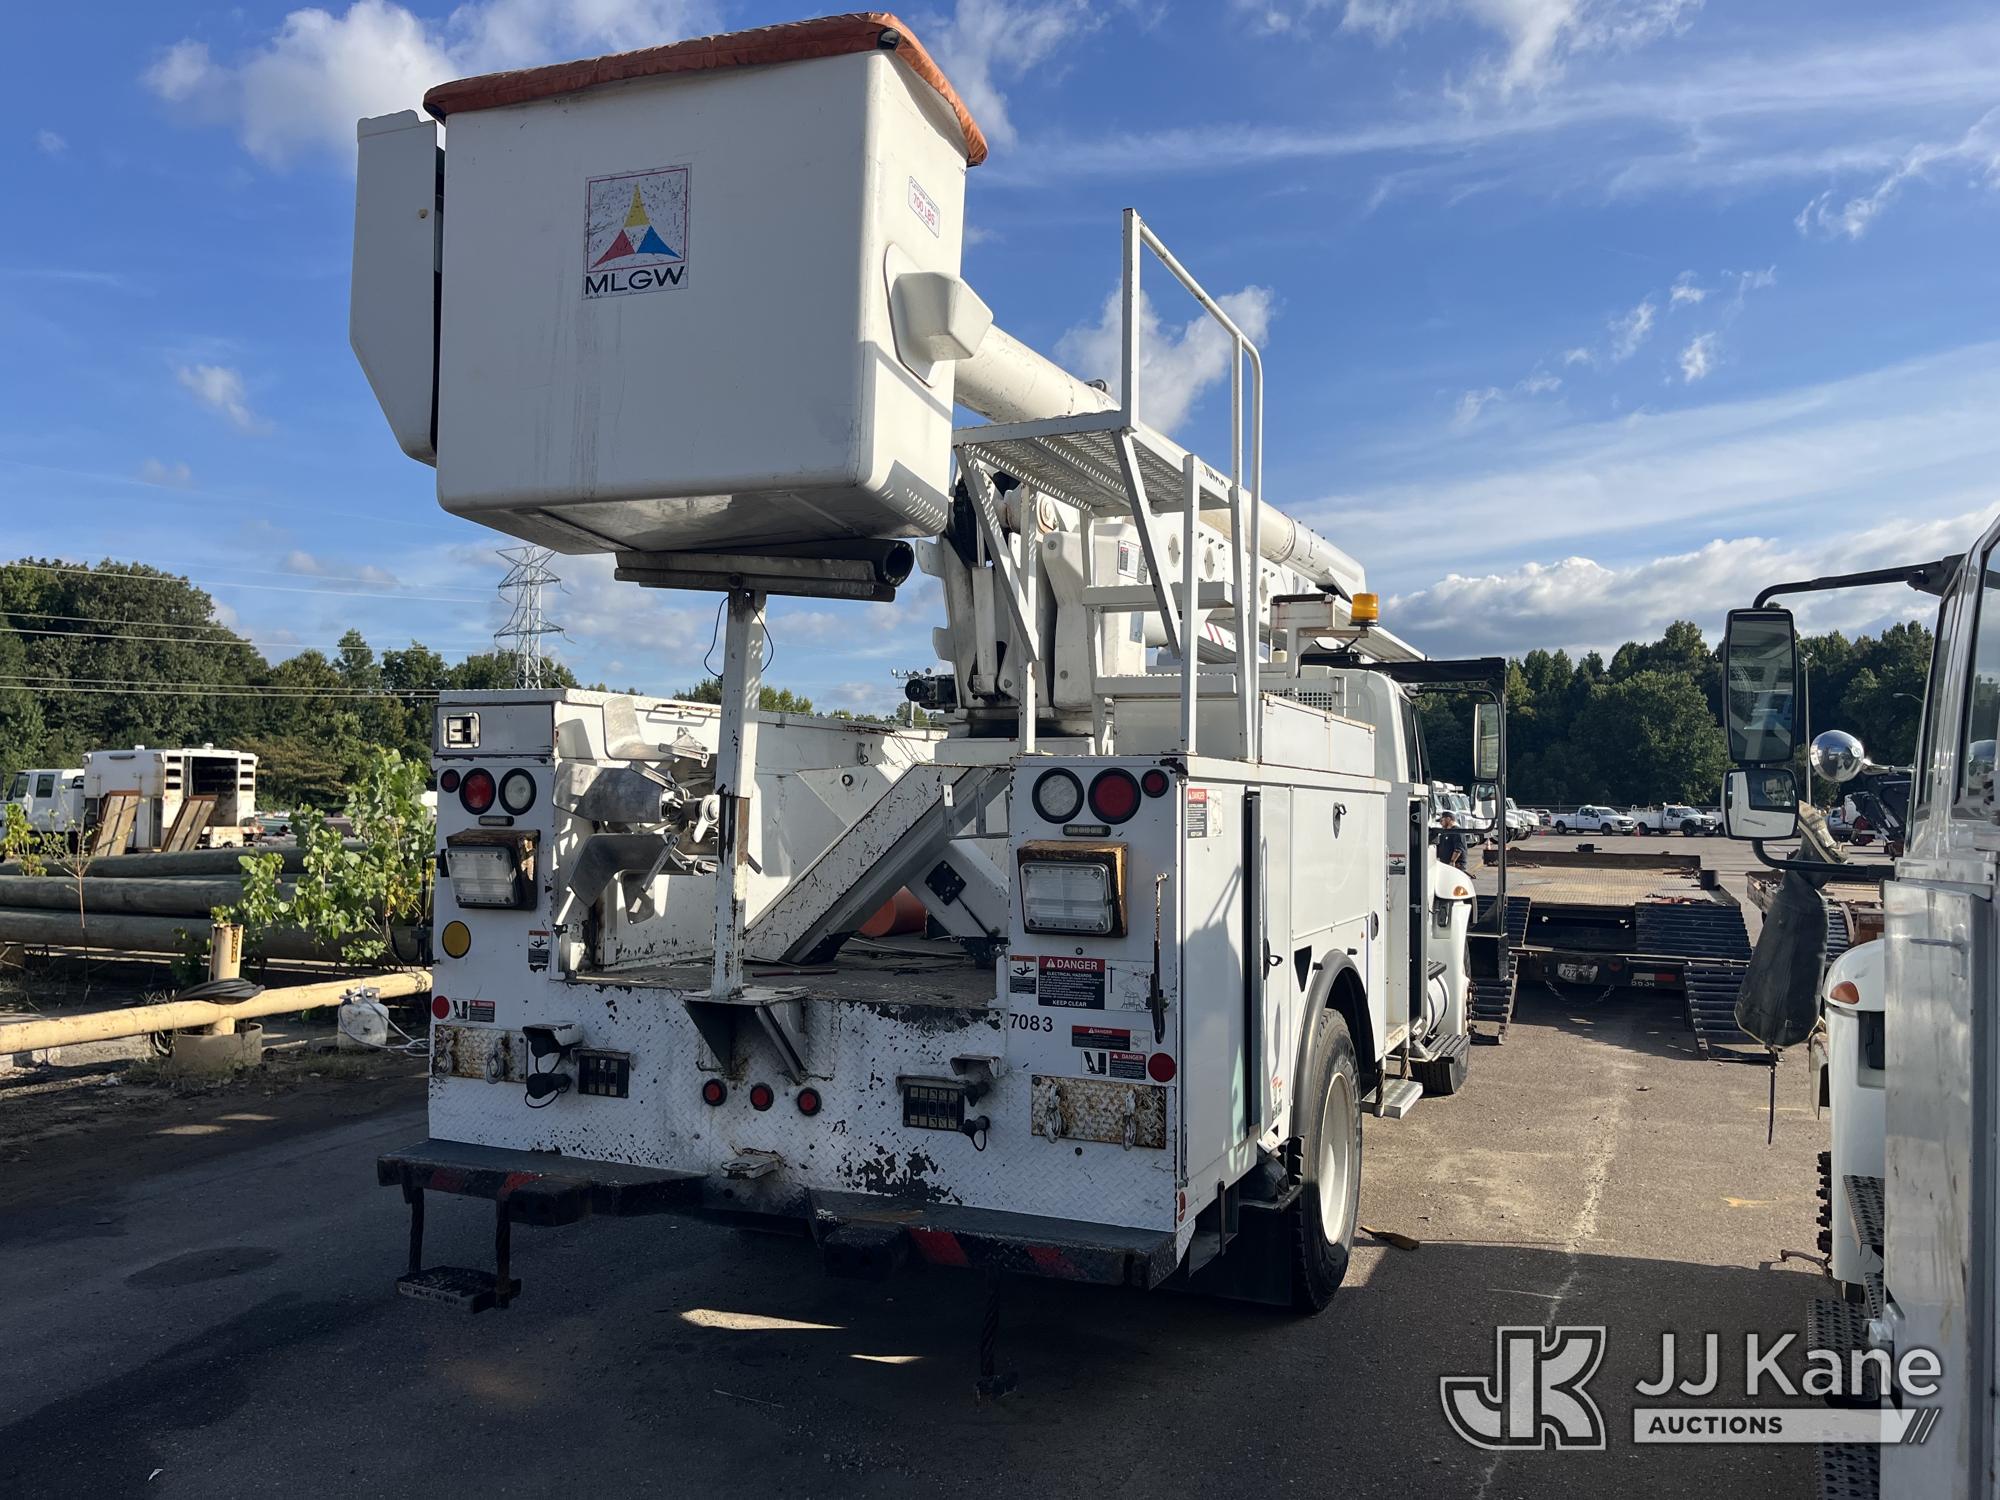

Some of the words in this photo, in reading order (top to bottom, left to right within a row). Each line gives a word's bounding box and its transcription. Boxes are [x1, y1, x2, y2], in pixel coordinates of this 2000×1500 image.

[913, 192, 924, 213] 700
[585, 266, 685, 295] MLGW
[1057, 959, 1098, 970] DANGER
[1009, 1013, 1053, 1032] 7083
